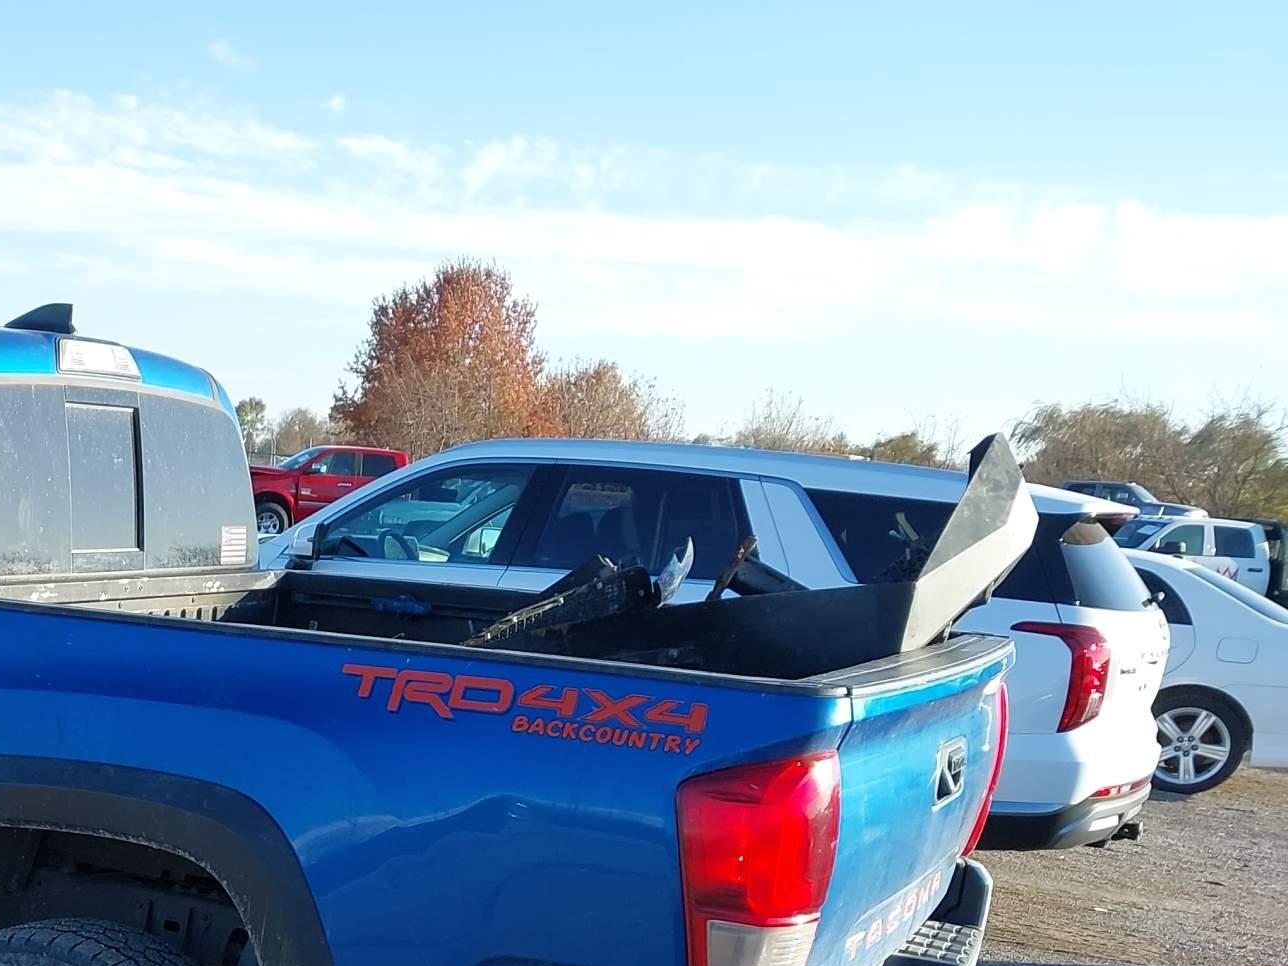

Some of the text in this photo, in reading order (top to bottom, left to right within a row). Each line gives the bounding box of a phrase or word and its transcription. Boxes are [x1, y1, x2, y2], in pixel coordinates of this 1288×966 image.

[343, 664, 514, 720] TRD
[511, 715, 701, 757] BACKCOUNTRY
[845, 870, 942, 960] TACOMA
